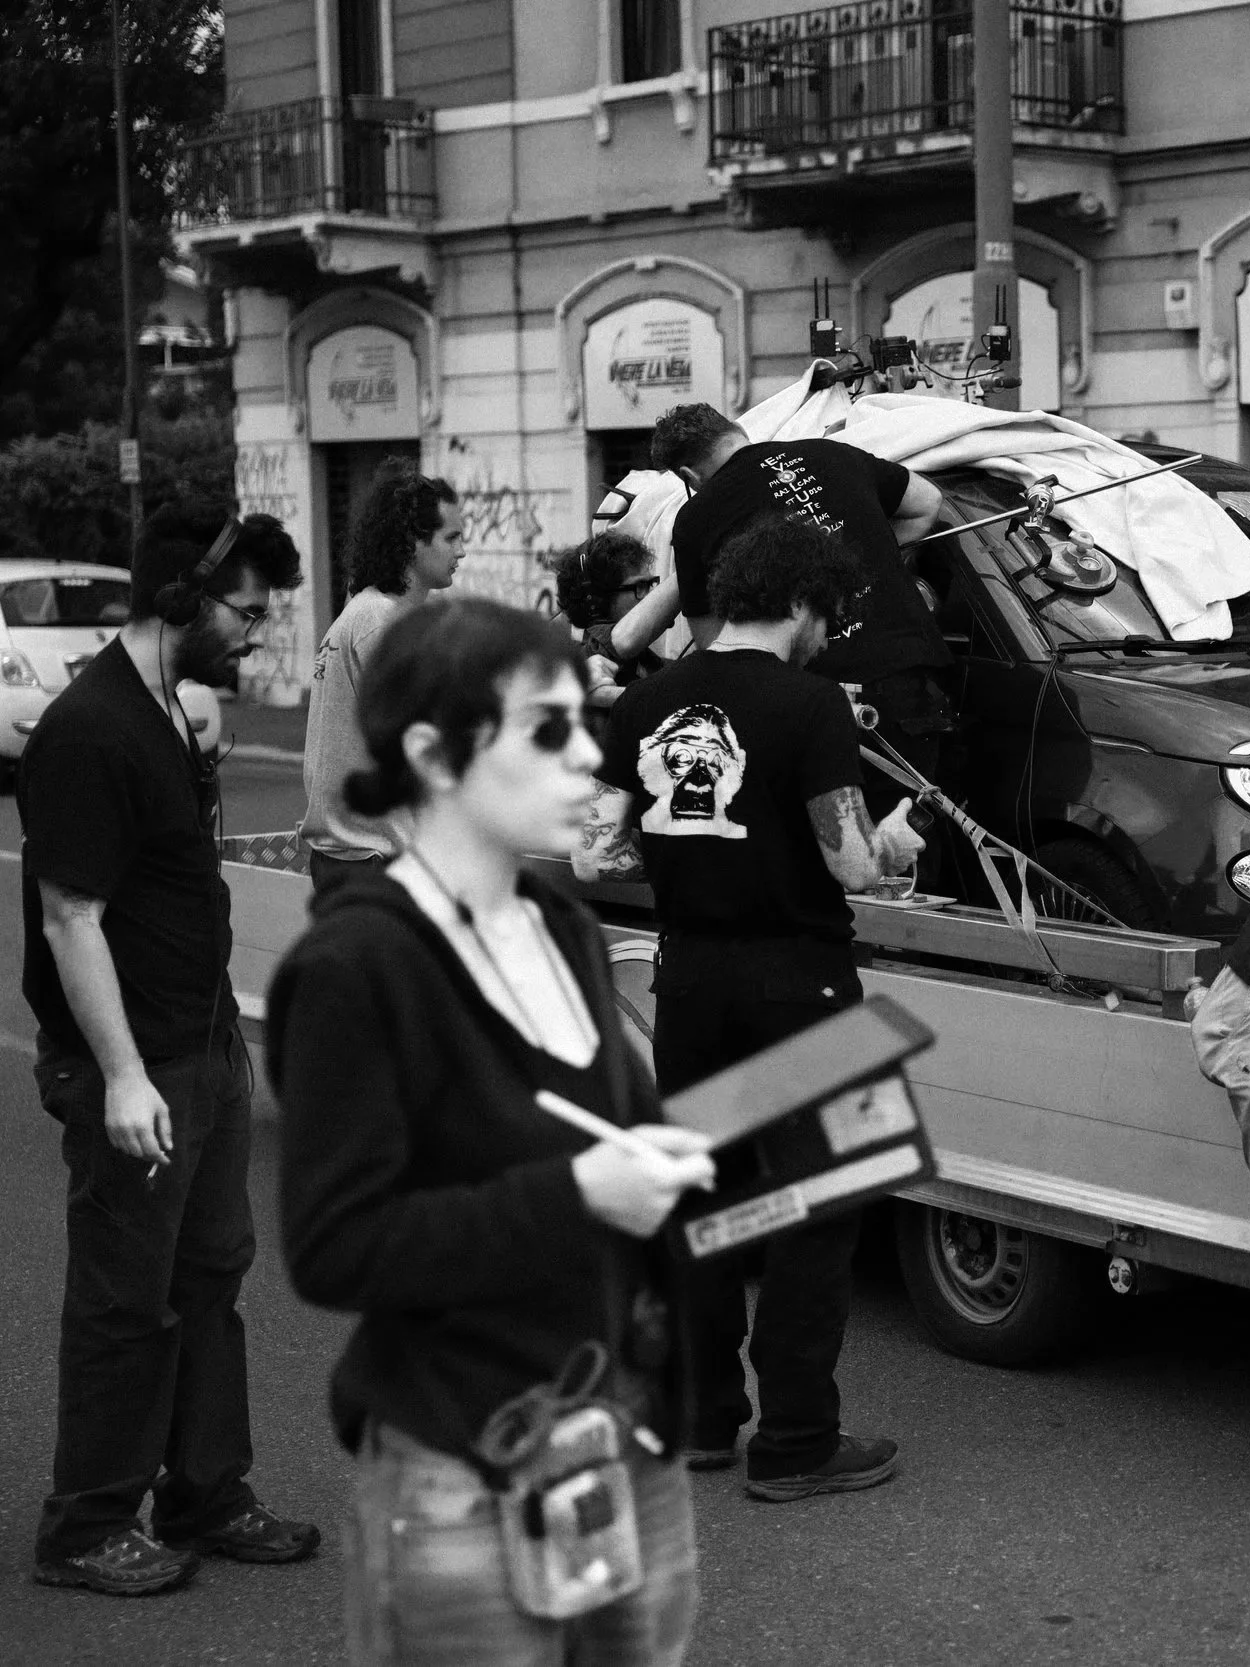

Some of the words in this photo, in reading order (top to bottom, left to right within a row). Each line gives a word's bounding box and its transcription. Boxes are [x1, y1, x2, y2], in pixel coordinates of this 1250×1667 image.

[759, 452, 786, 469] RENT
[770, 457, 804, 473] VIDEO
[785, 486, 823, 506] STUDIO
